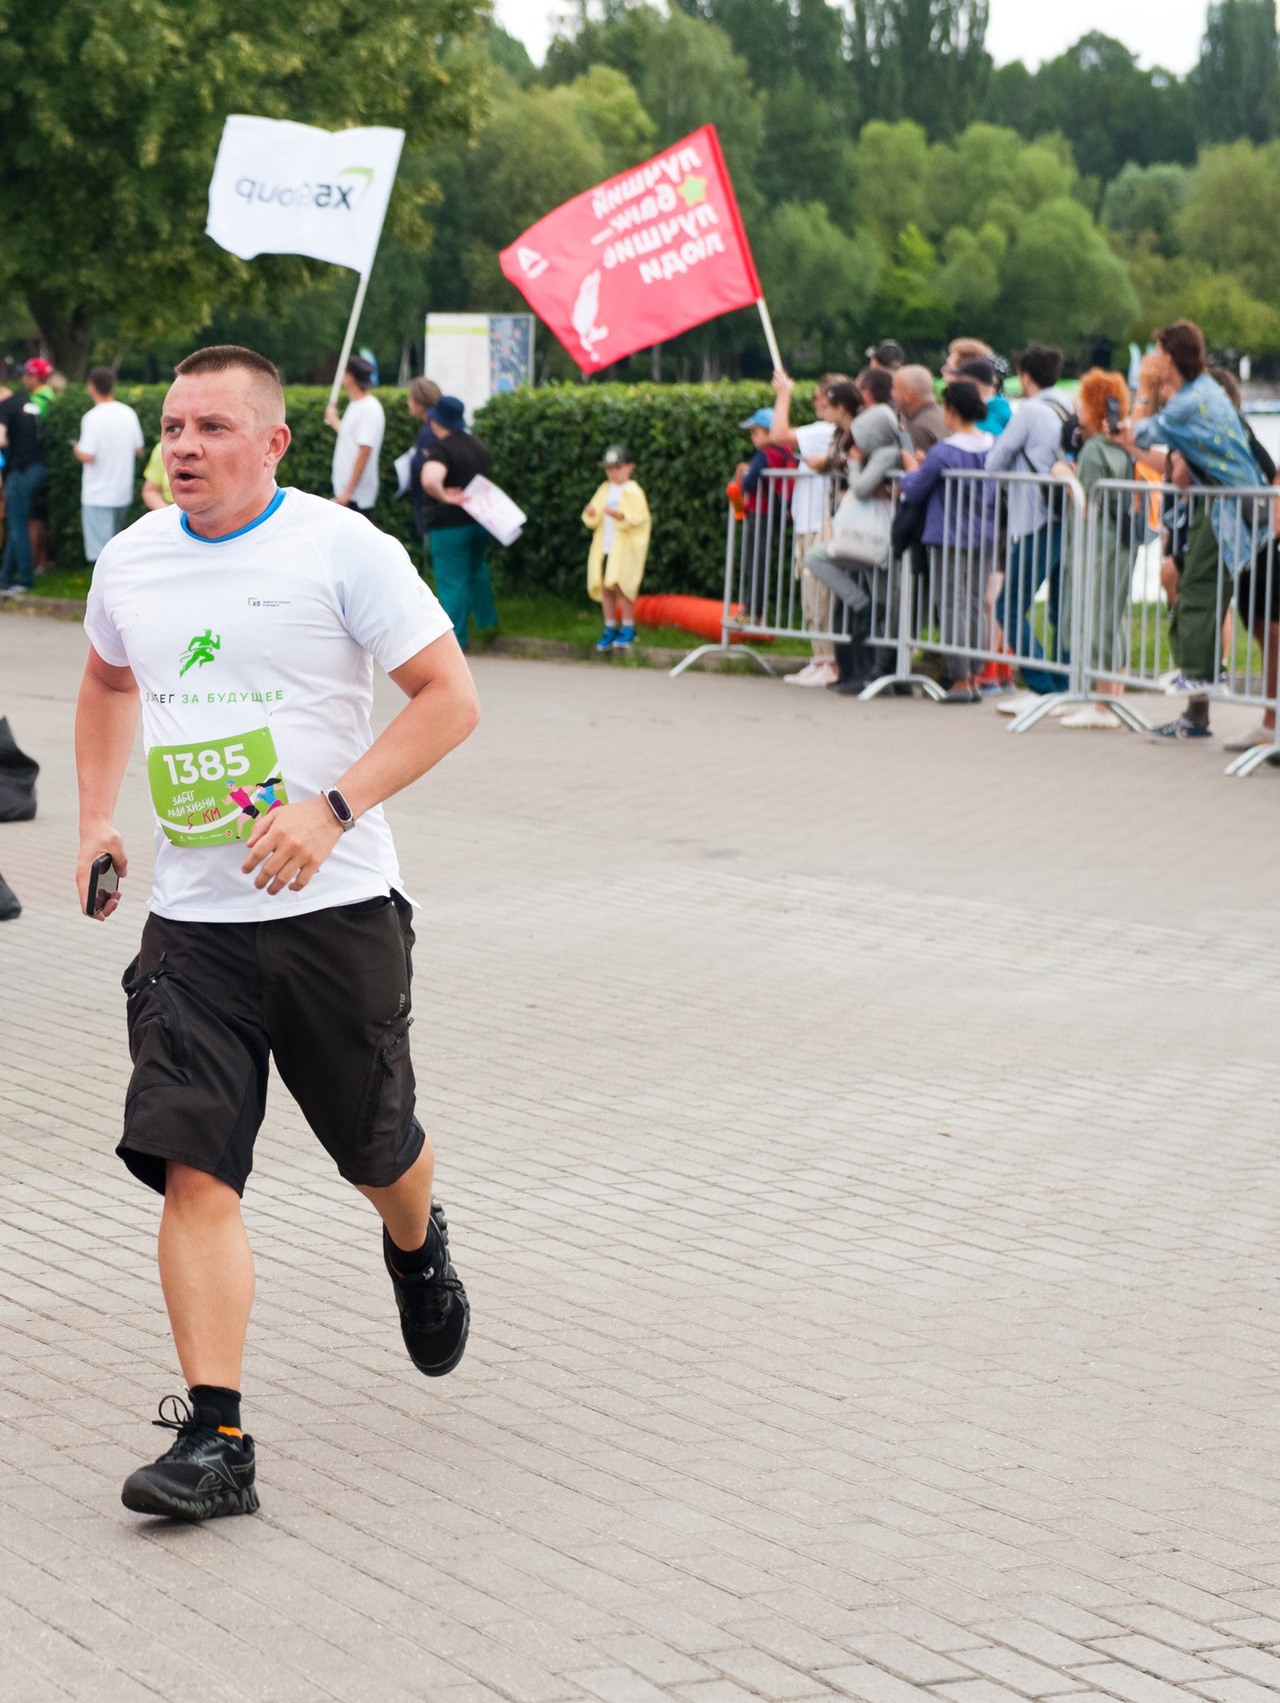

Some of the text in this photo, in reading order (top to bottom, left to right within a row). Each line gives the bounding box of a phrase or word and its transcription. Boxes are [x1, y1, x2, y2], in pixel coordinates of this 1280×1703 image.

[181, 693, 200, 704] ЗА
[207, 690, 284, 704] БУДУЩЕЕ
[163, 743, 250, 785] 1385
[172, 790, 194, 806] ЗАБЕГ
